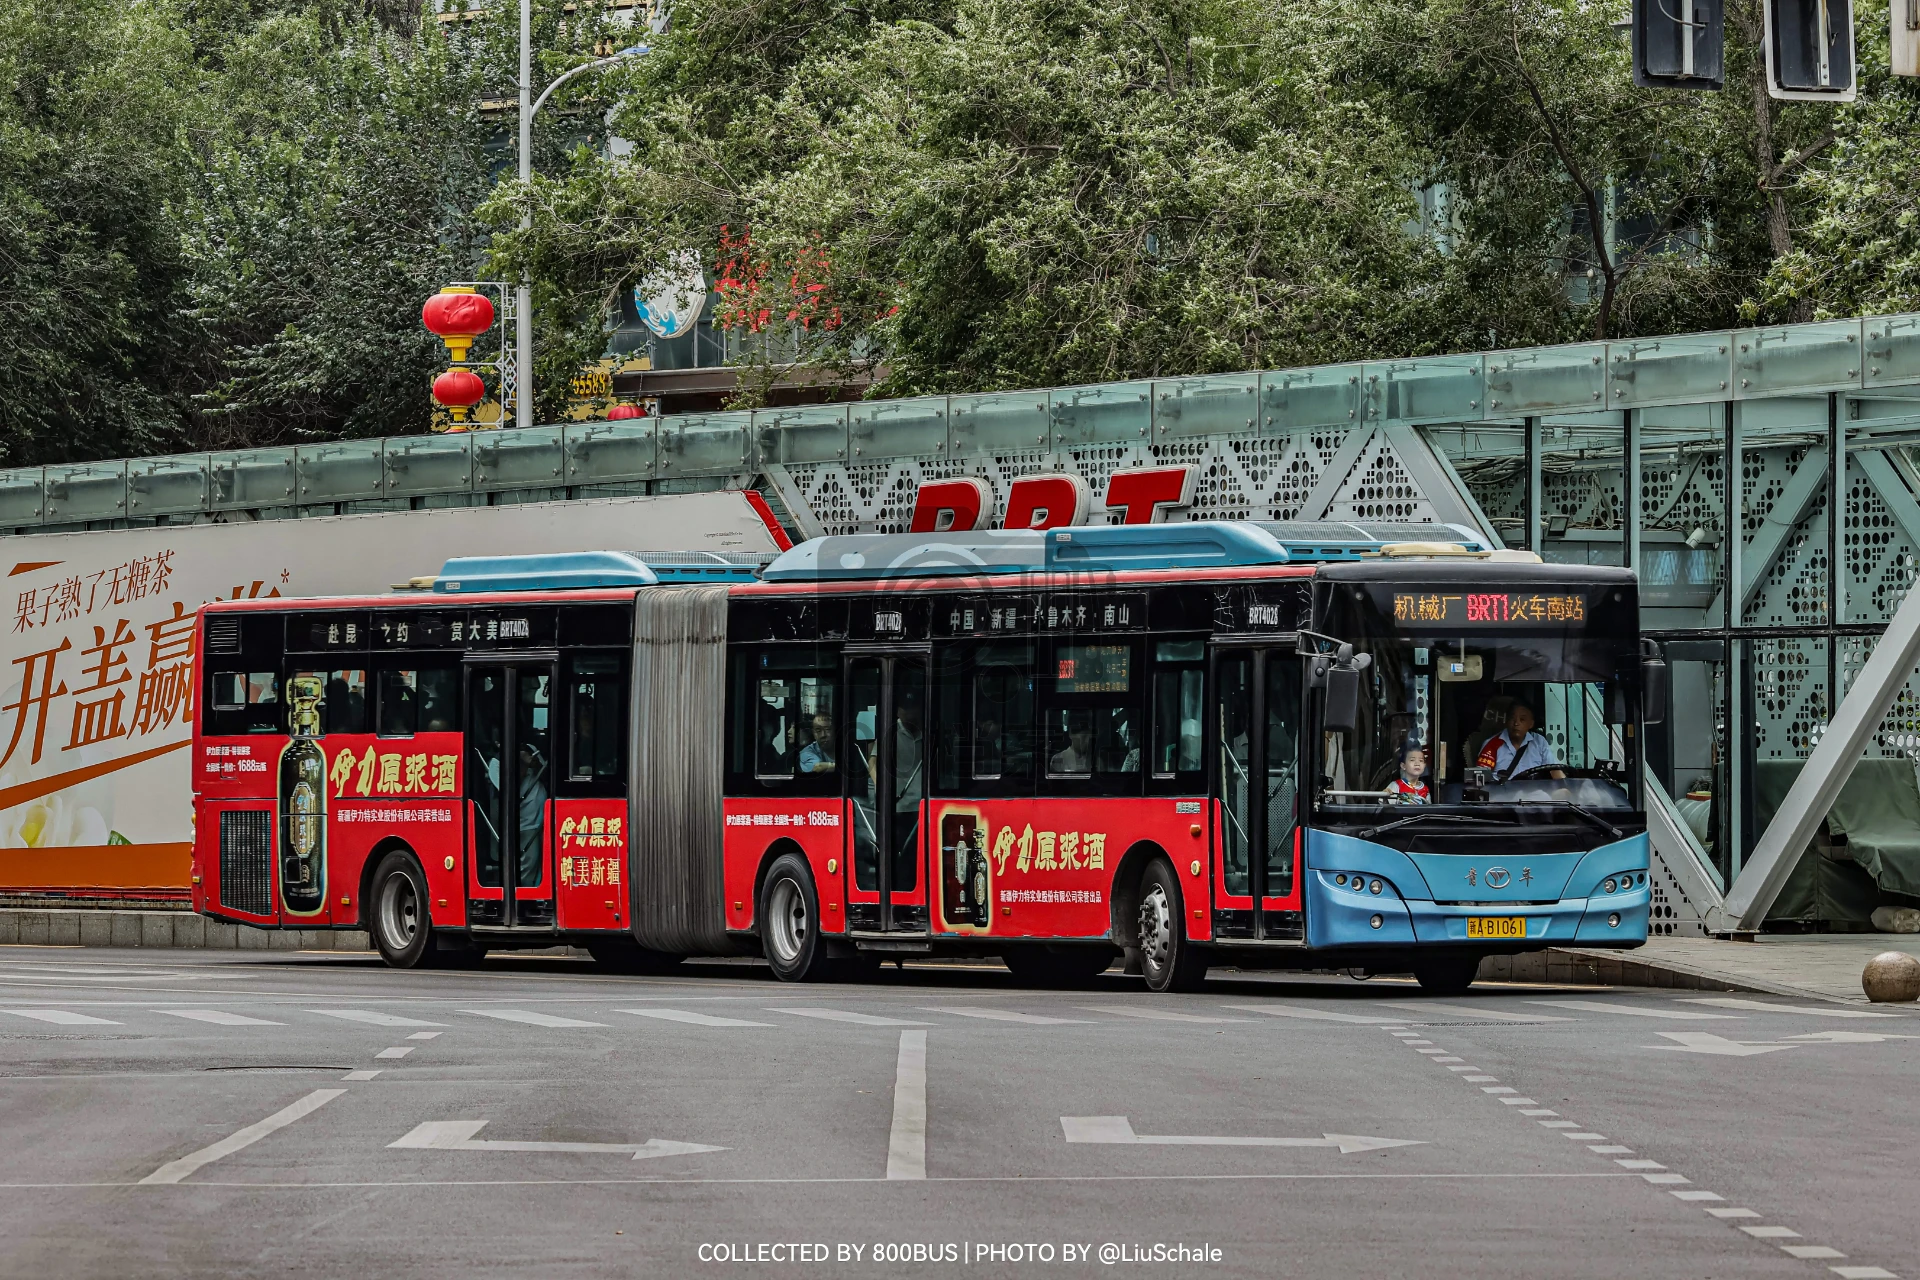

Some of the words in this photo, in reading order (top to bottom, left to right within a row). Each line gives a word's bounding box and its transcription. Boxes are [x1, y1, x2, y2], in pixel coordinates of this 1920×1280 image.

[11, 549, 175, 634] 果子熟了无糖茶
[1394, 594, 1462, 621] 机械厂
[1466, 594, 1509, 621] BRT1
[1511, 595, 1584, 621] 火车南站
[1249, 606, 1278, 625] BRT4028
[0, 581, 282, 768] 开盖赢
[330, 745, 458, 797] 伊力原浆酒
[337, 809, 451, 822] 新疆伊力特实业股份有限公司荣誉出品
[560, 815, 623, 849] 伊力原浆
[993, 823, 1106, 876] 伊力原浆酒
[1000, 890, 1102, 903] 新疆伊力特实业股份有限公司荣誉出品
